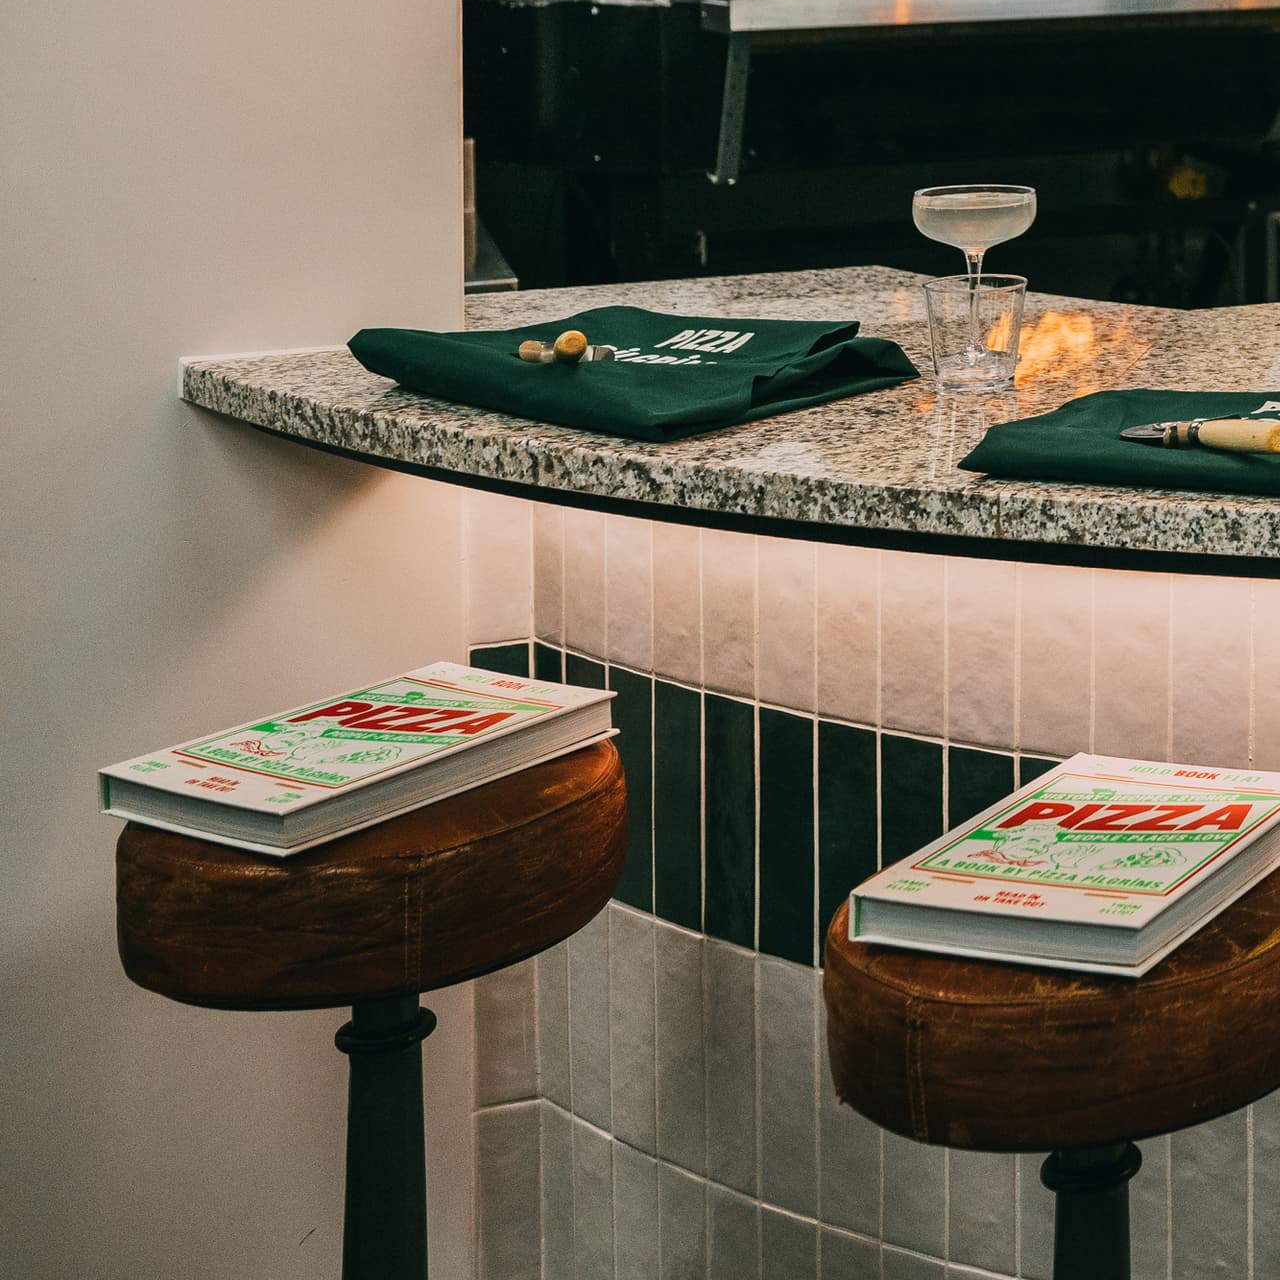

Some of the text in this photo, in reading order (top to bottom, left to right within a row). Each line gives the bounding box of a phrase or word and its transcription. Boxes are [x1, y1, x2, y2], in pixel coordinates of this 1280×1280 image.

[654, 329, 755, 353] PIZZA
[492, 680, 526, 691] BOOK
[287, 701, 517, 735] PIZZA
[208, 748, 240, 760] BOOK
[238, 754, 261, 763] BY
[1129, 765, 1263, 784] HOLD BOOK FLAT
[995, 802, 1253, 831] PIZZA
[1063, 832, 1233, 842] PEOPLE PLACES LOVE
[938, 859, 950, 867] A
[953, 862, 996, 873] BOOK
[1004, 866, 1024, 875] BY
[992, 896, 1023, 906] TAKE
[1022, 900, 1048, 908] OUT
[994, 890, 1027, 899] READ
